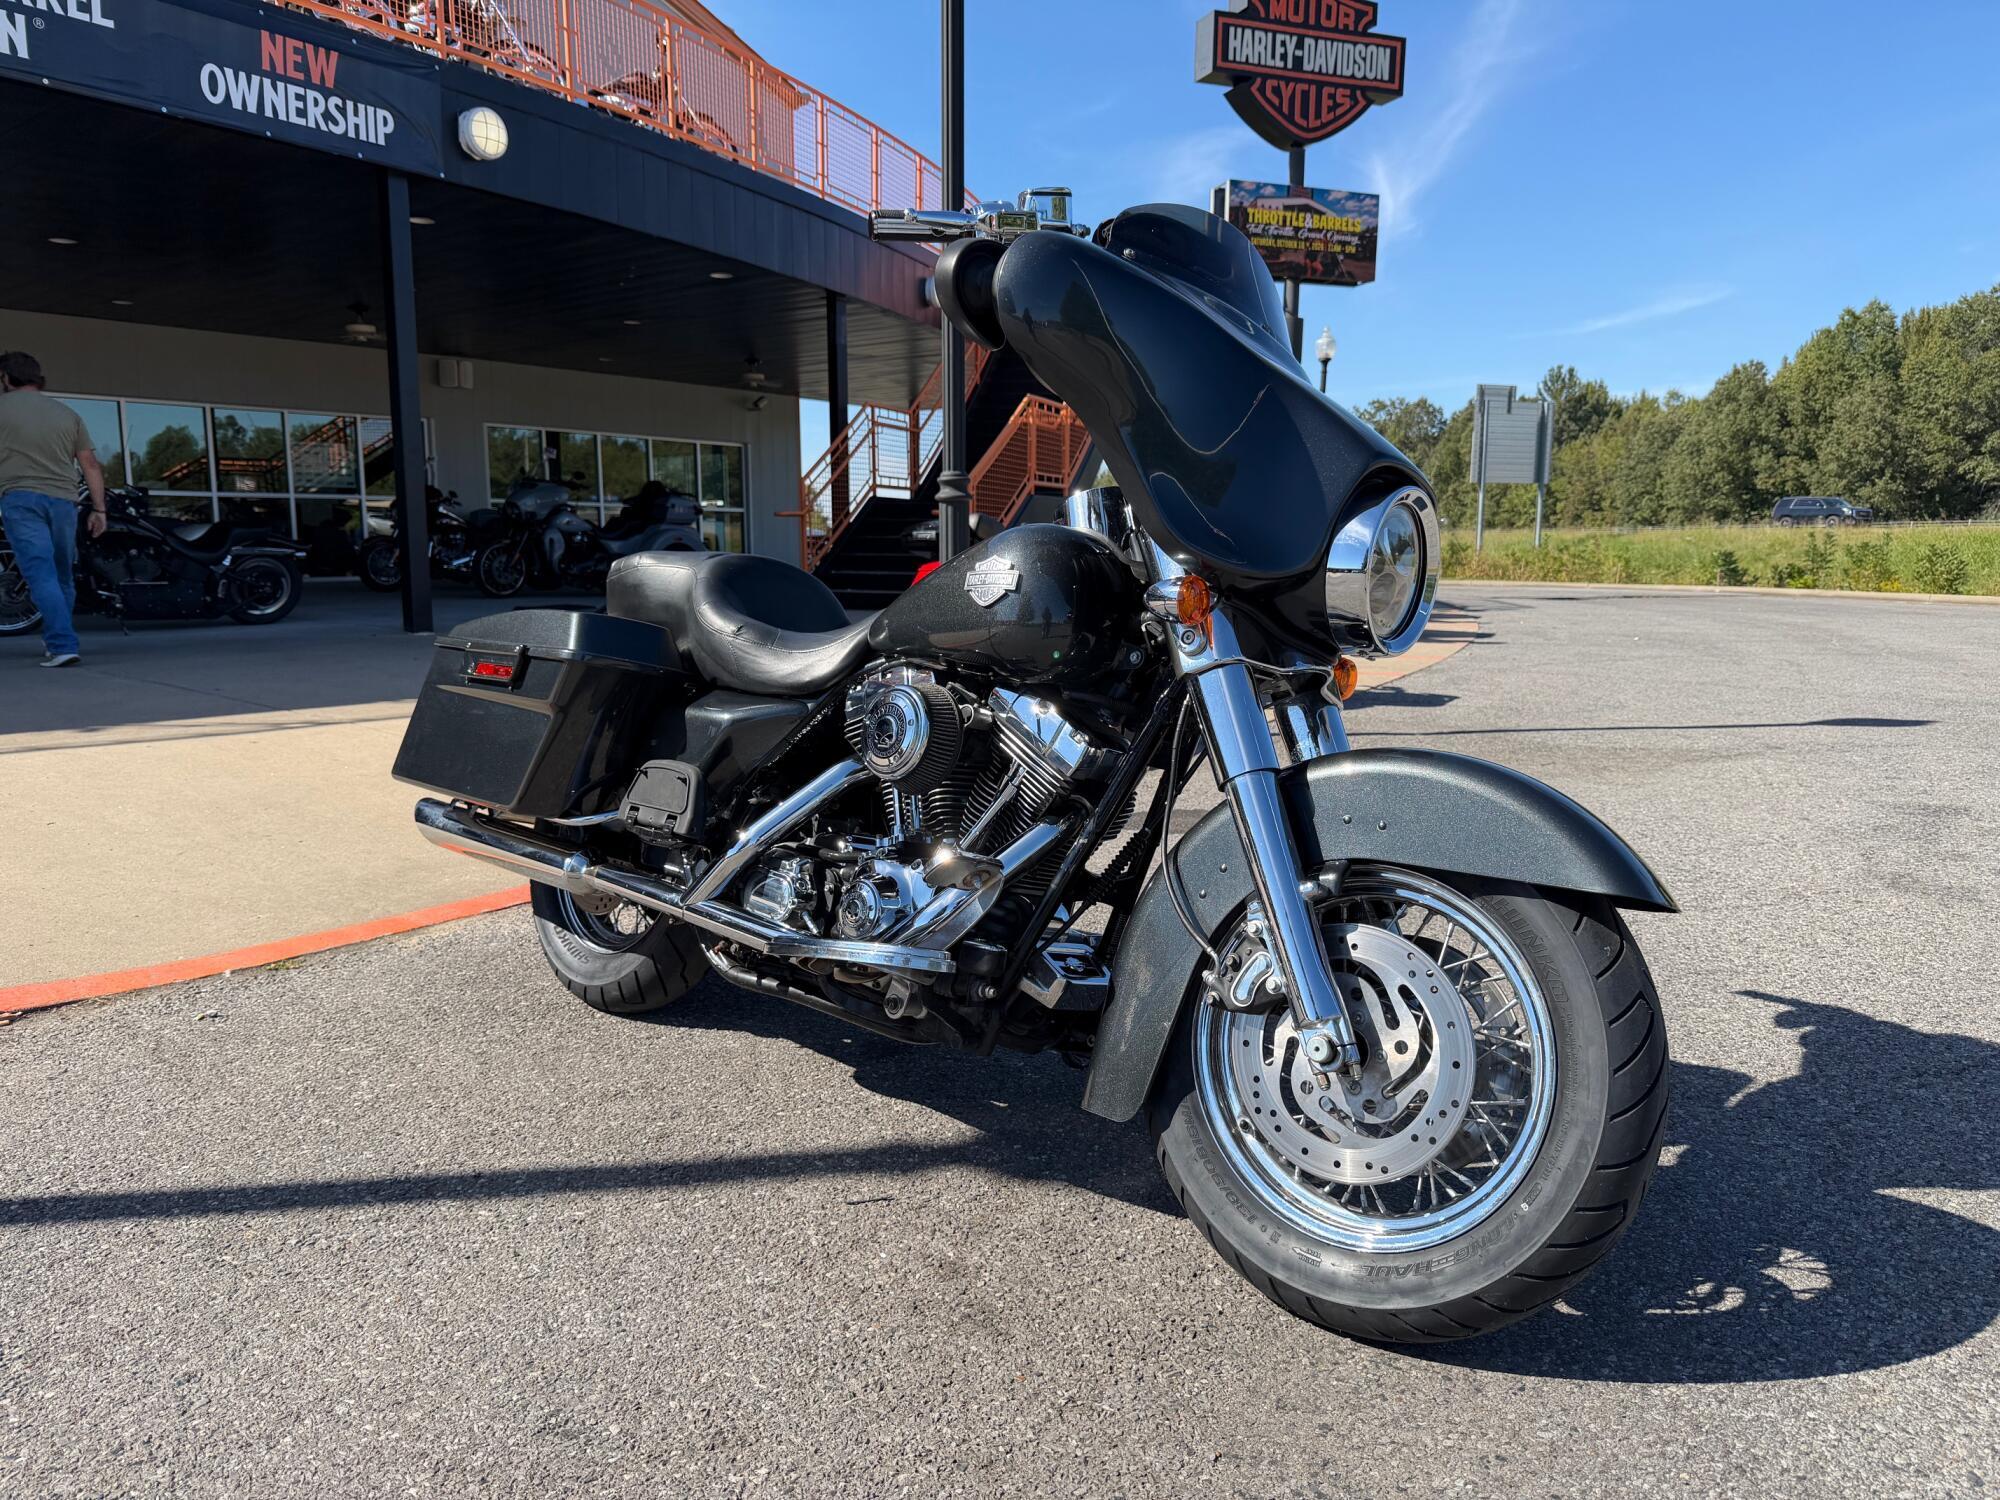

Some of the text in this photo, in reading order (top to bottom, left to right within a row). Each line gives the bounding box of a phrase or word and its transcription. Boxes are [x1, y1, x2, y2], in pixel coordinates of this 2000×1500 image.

[259, 29, 340, 89] NEW
[1227, 25, 1391, 81] HARLEY-DAVIDSON
[199, 62, 395, 146] OWNERSHIP
[1265, 78, 1355, 129] CYCLES
[553, 925, 592, 965] SHINKO
[1361, 1259, 1432, 1278] HAUL
